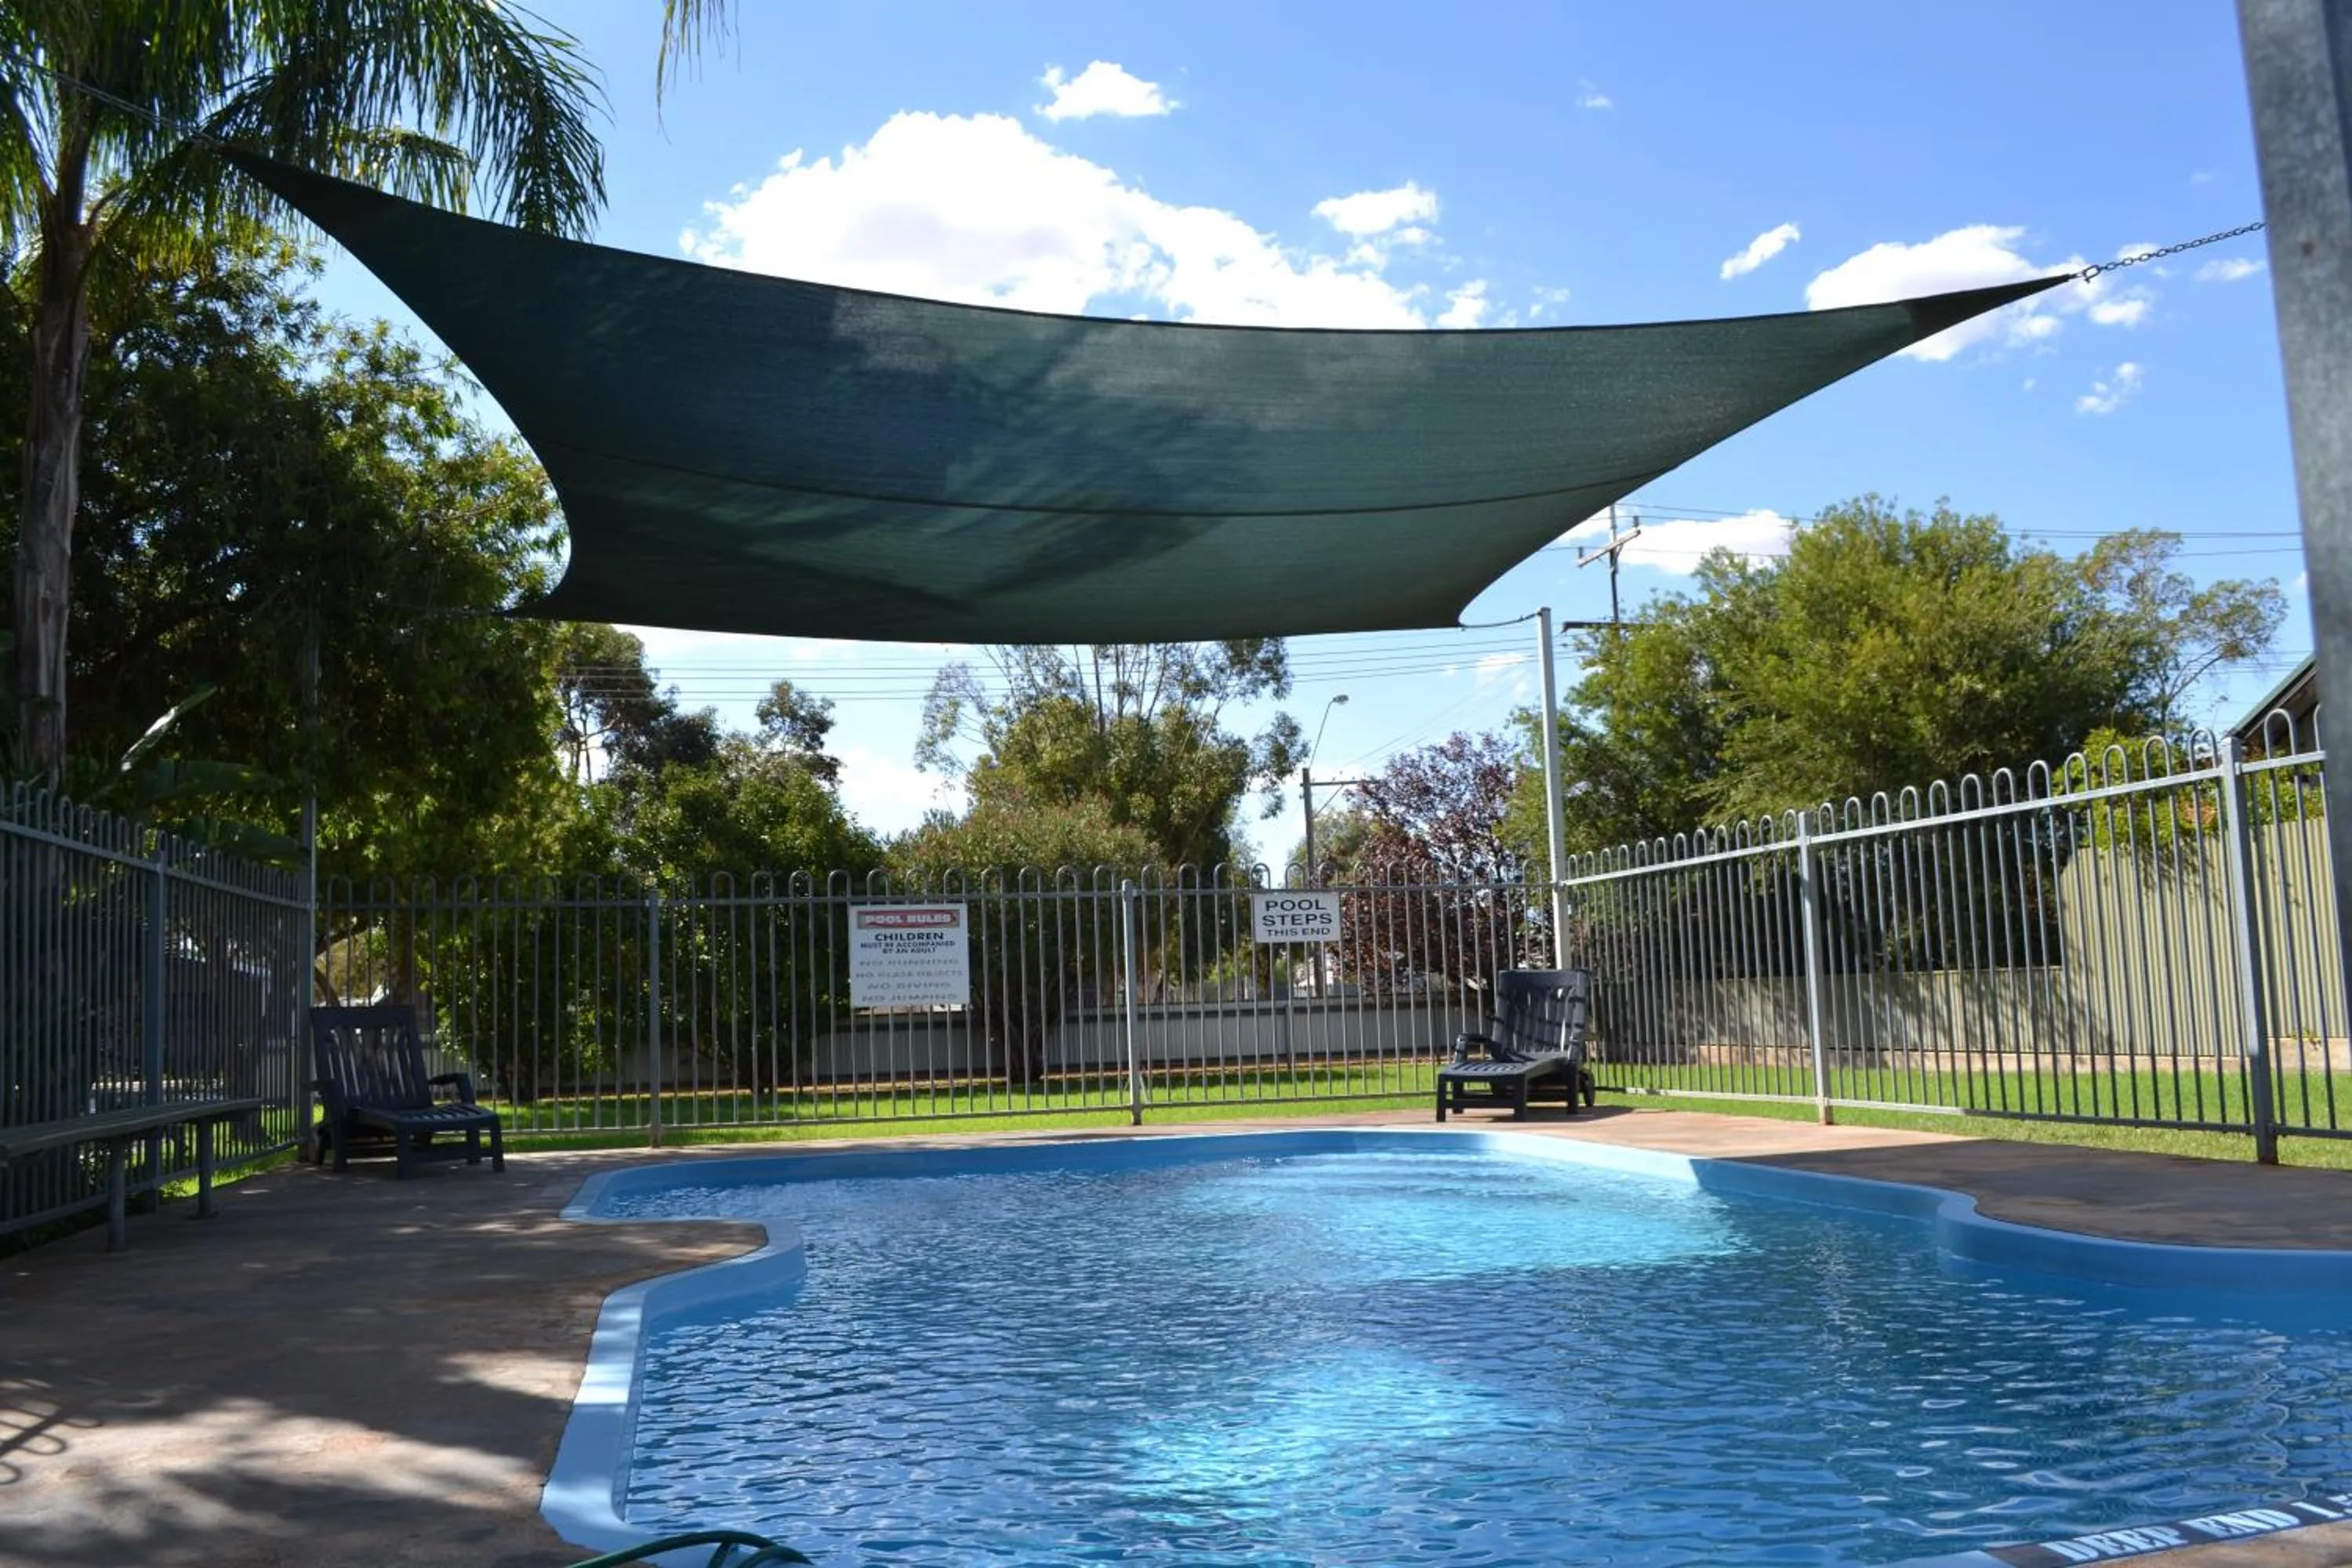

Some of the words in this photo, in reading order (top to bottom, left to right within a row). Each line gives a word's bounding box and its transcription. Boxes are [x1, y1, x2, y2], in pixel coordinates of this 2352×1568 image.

[1265, 898, 1327, 911] POOL
[1262, 913, 1333, 926] STEPS
[874, 932, 944, 942] CHILDREN
[2039, 1526, 2190, 1562] DEEP
[2180, 1508, 2300, 1538] END
